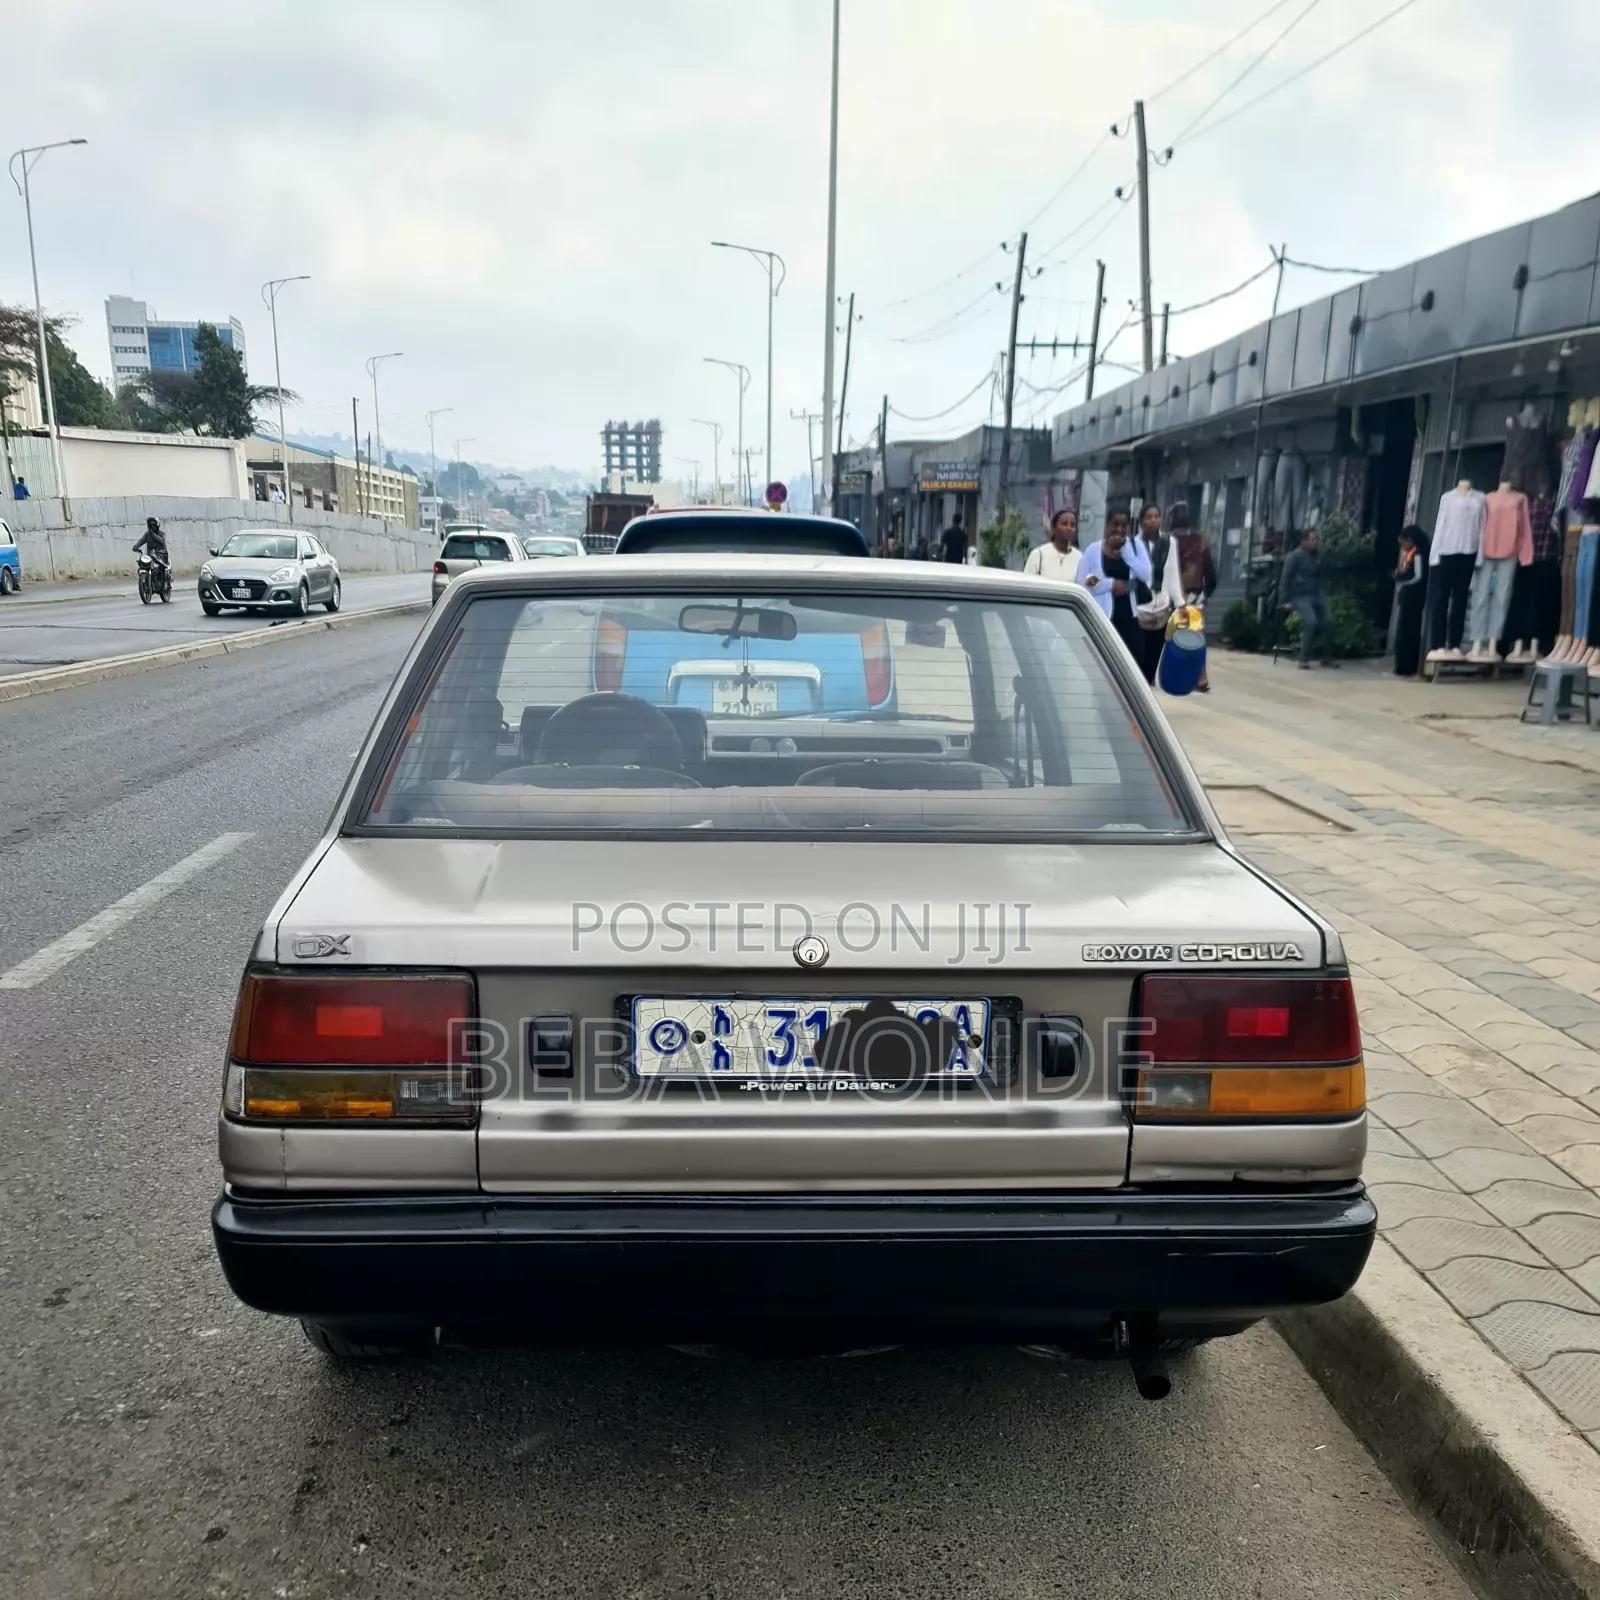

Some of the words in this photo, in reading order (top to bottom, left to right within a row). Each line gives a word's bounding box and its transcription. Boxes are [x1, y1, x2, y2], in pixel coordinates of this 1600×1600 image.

[947, 480, 979, 489] BAKERY
[292, 933, 352, 958] DX
[1090, 945, 1169, 961] TOYOTA
[1180, 943, 1303, 961] COROLLA
[805, 1080, 833, 1092] auf
